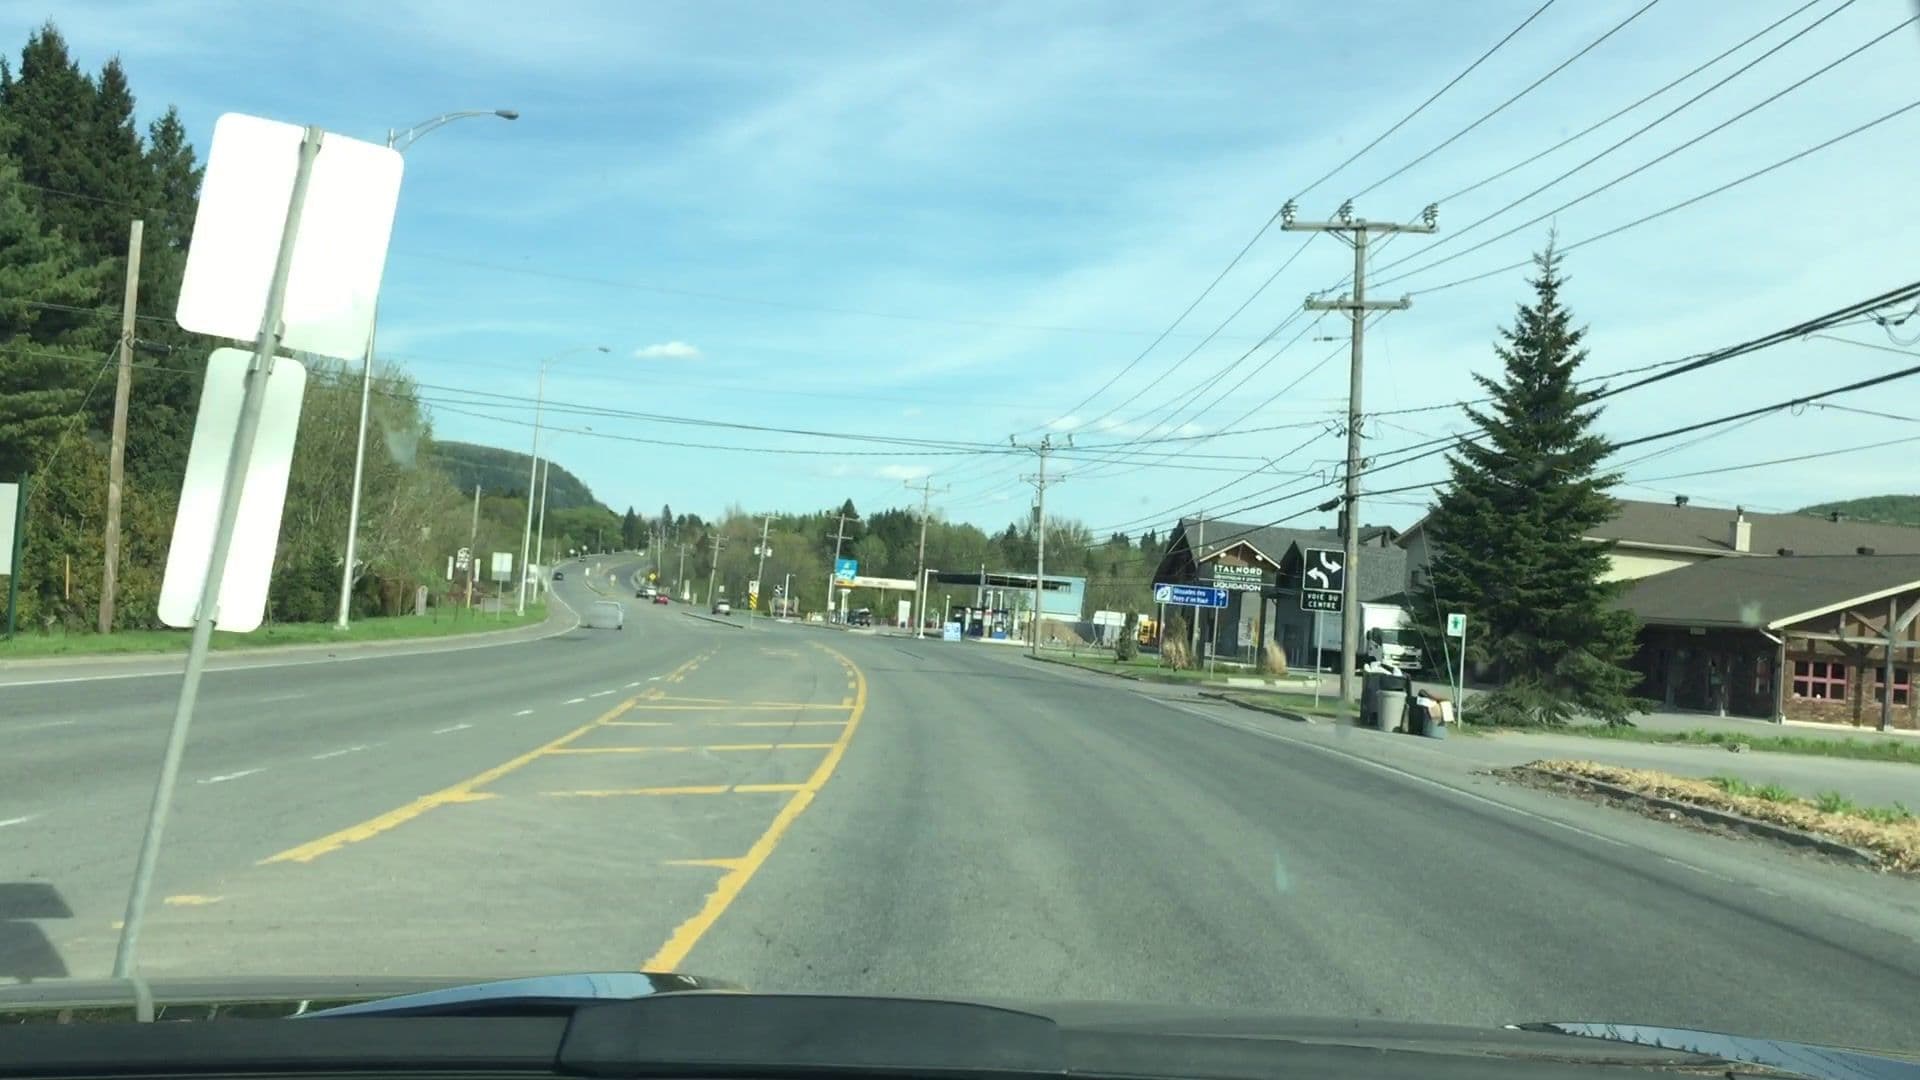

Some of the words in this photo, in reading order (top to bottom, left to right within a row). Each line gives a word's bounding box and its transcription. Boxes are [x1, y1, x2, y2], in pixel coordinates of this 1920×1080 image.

[1214, 564, 1262, 576] ITALNORD
[1213, 581, 1261, 591] LIQUIDATION
[1307, 593, 1324, 601] VOIE
[1308, 601, 1335, 609] CENTRE
